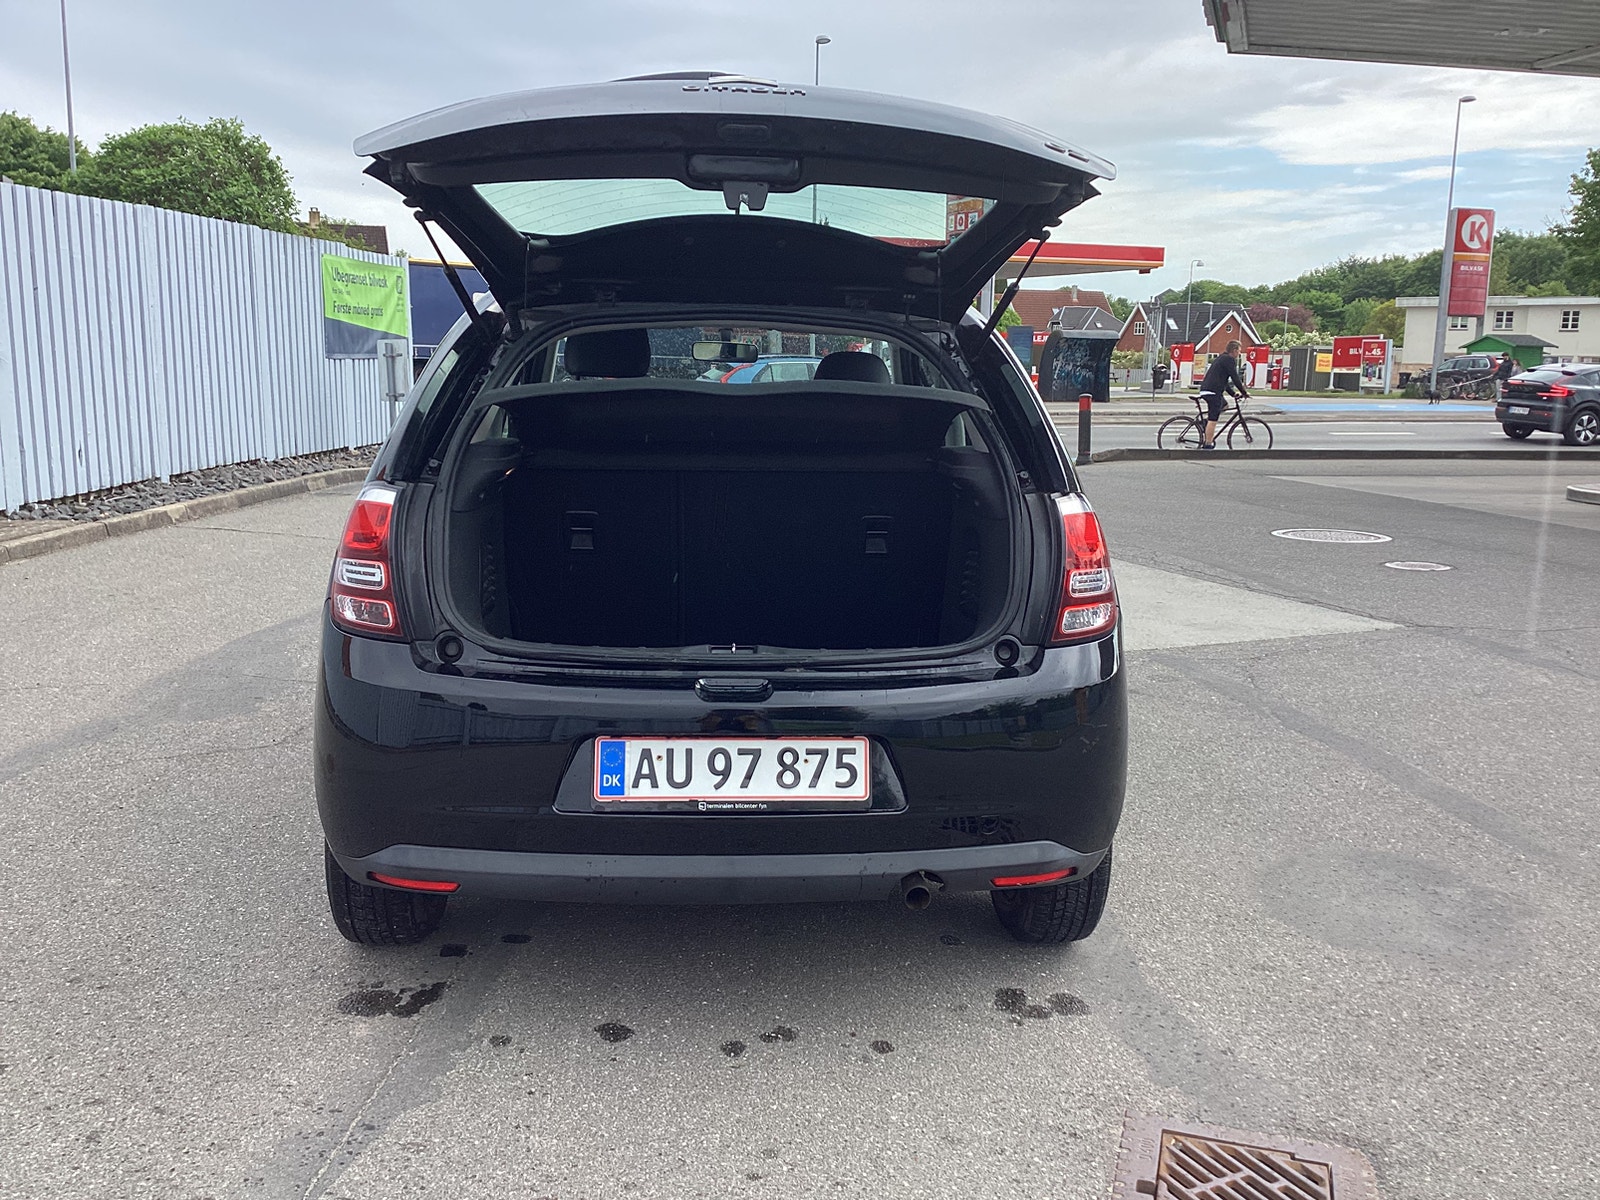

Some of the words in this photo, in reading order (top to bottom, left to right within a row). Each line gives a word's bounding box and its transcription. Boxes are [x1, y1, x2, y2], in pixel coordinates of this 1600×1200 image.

[331, 266, 368, 288] Ubegrænset
[631, 747, 693, 789] AU
[707, 747, 762, 790] 97
[776, 746, 858, 789] 875
[603, 774, 621, 787] DK
